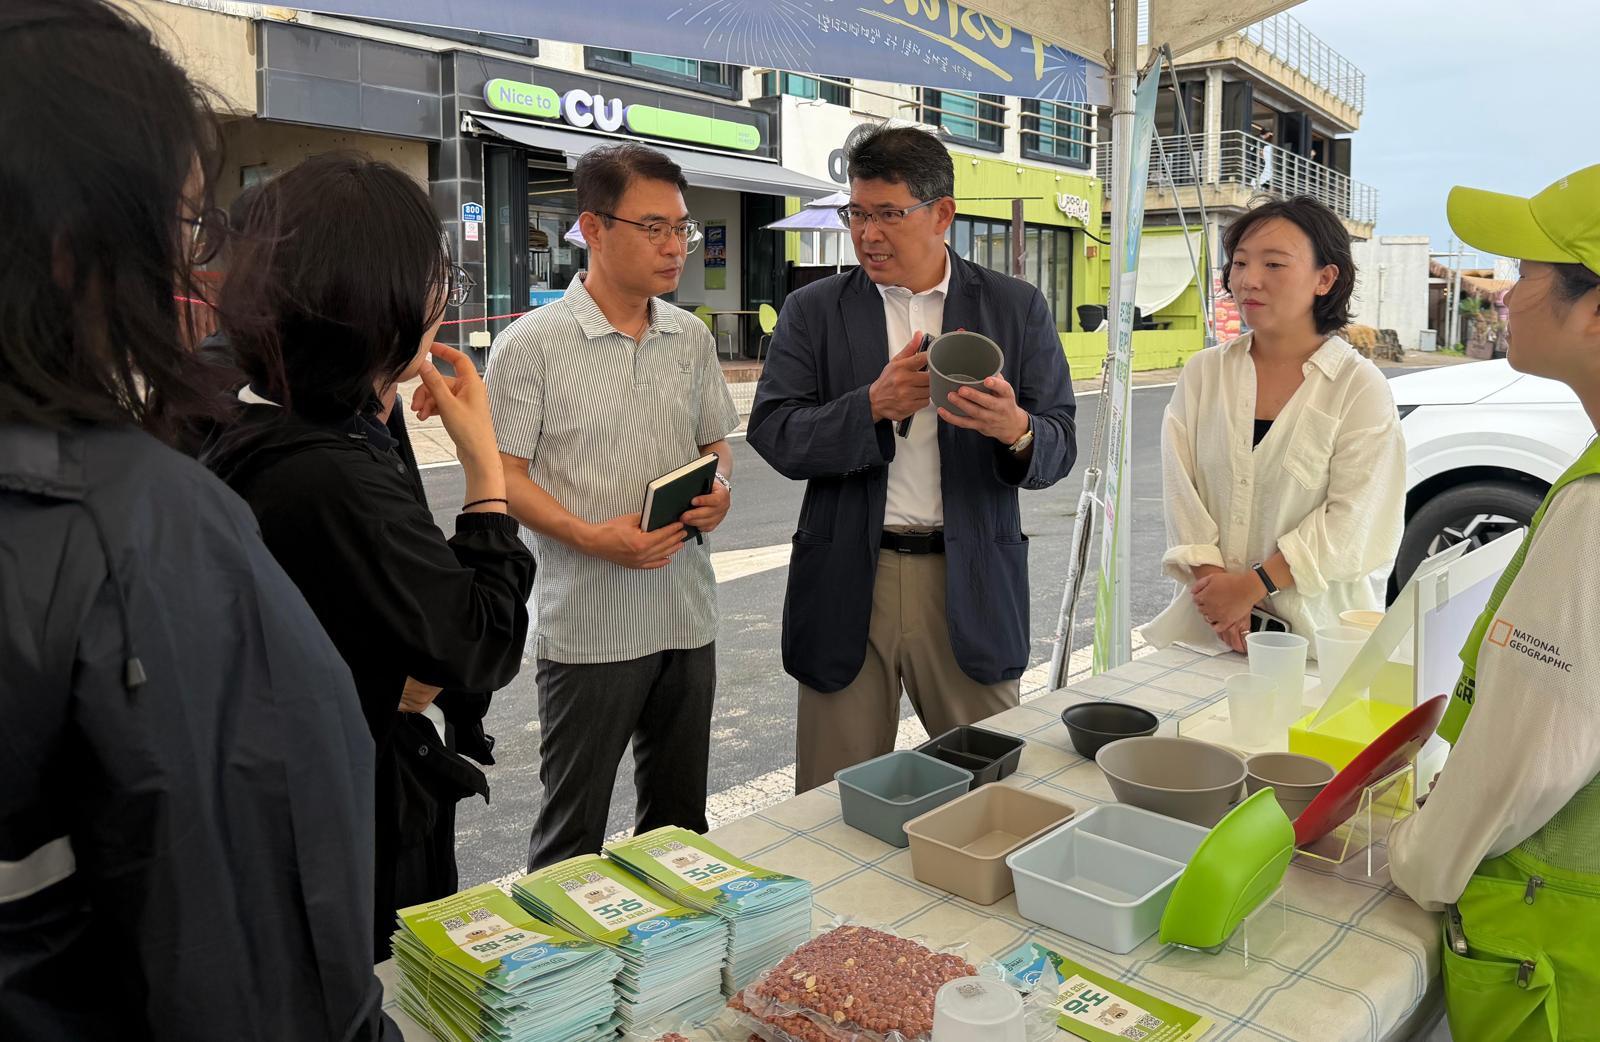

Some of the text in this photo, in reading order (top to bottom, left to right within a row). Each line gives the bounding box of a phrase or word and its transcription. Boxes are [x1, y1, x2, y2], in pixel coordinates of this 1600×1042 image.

[499, 86, 623, 132] Nice to CU
[465, 205, 480, 214] 800
[1512, 628, 1561, 656] NATIONAL
[1509, 640, 1573, 673] GEOGRAPHIC
[683, 862, 729, 882] 우도
[592, 897, 645, 920] 우도
[1063, 989, 1109, 1015] 우도
